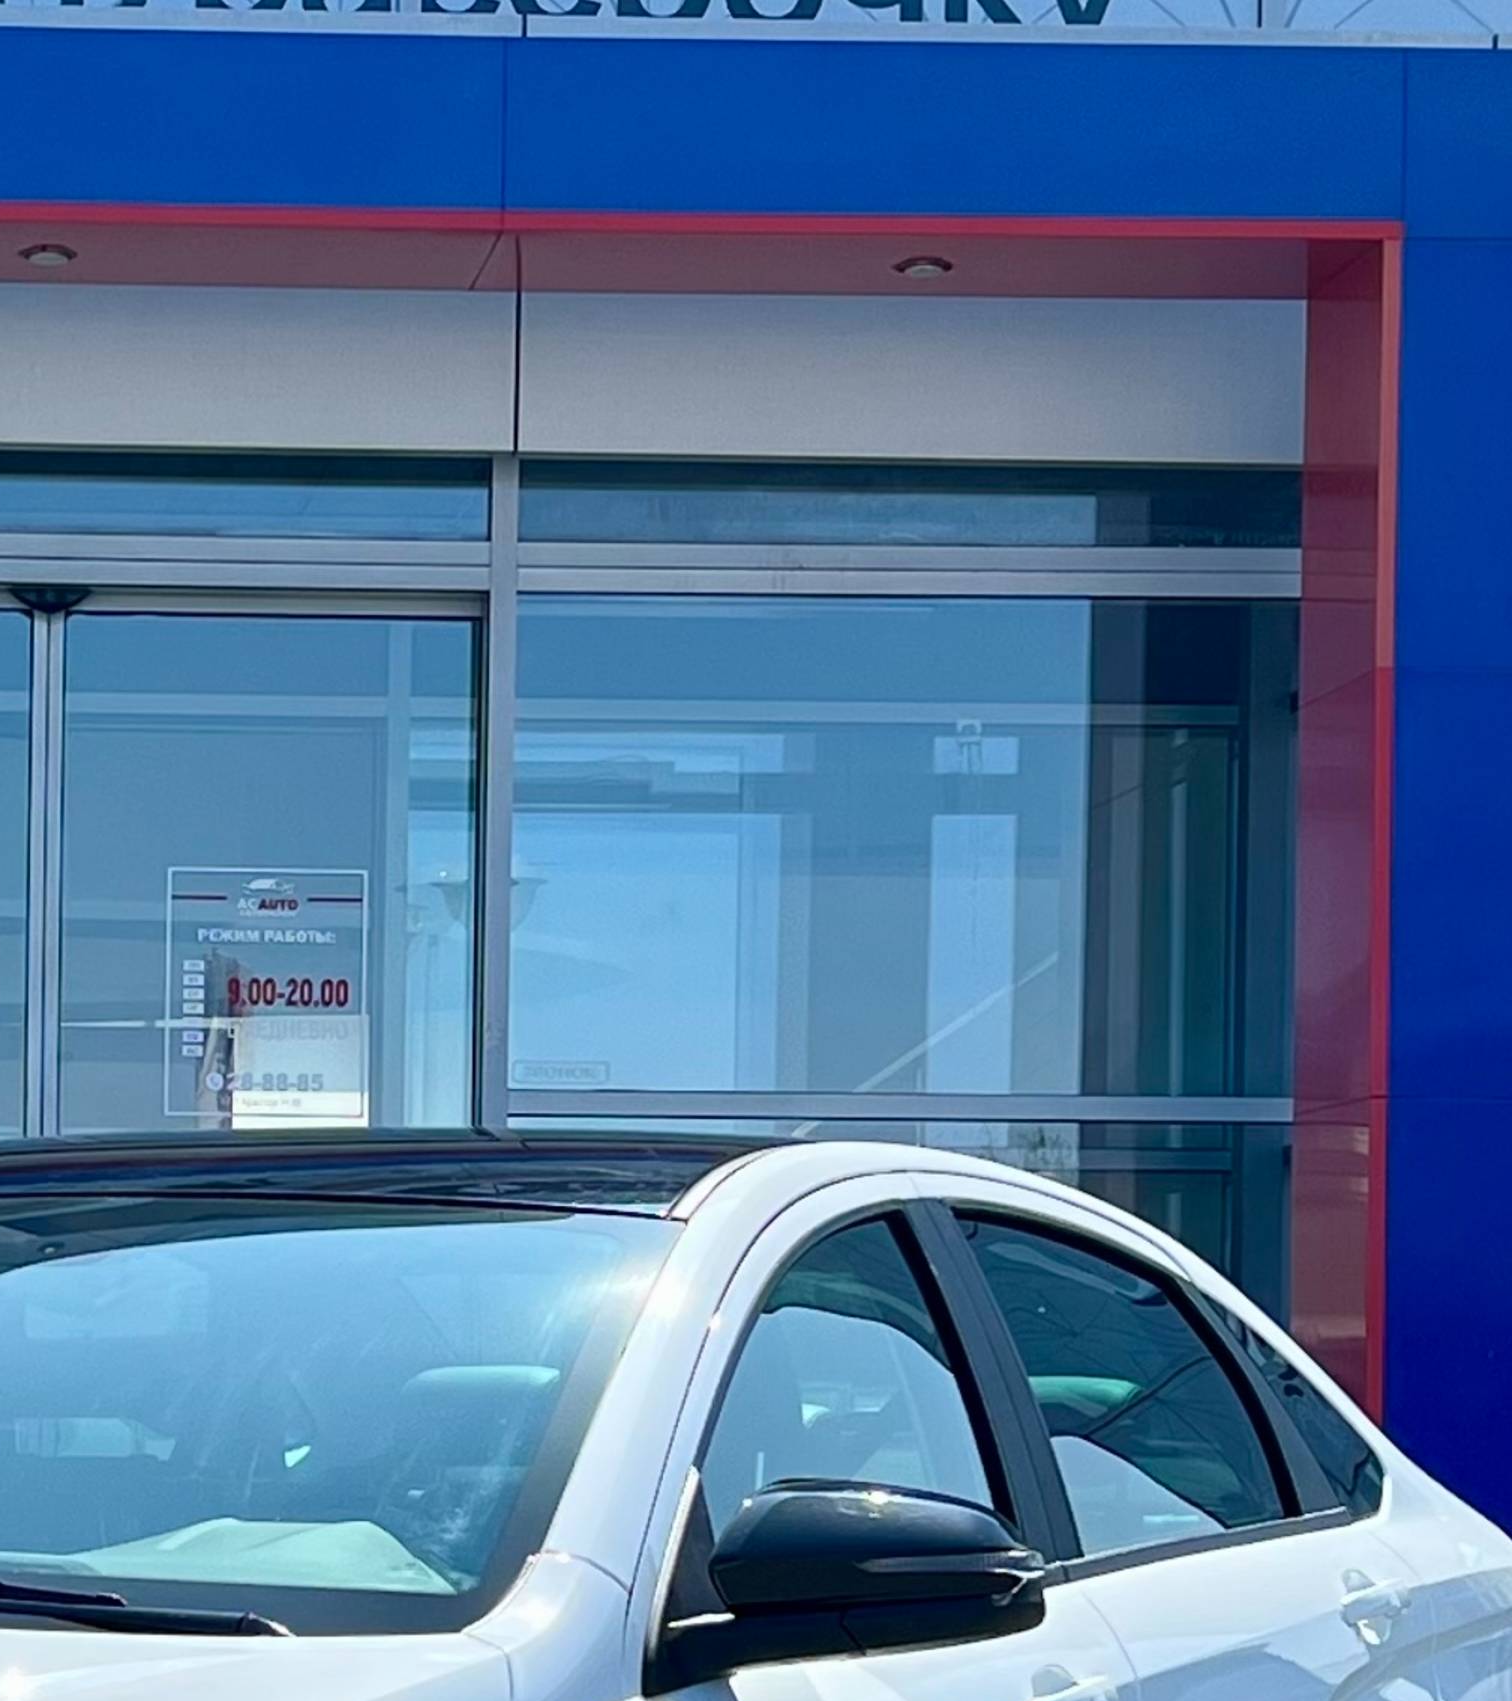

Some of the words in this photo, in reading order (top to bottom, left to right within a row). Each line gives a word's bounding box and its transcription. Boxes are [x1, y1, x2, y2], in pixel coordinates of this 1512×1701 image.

[257, 898, 299, 911] AUTO
[197, 928, 259, 943] РЕЖИМ
[227, 977, 350, 1008] 9.00-20.00
[228, 1019, 350, 1042] ЕДНЕВНО
